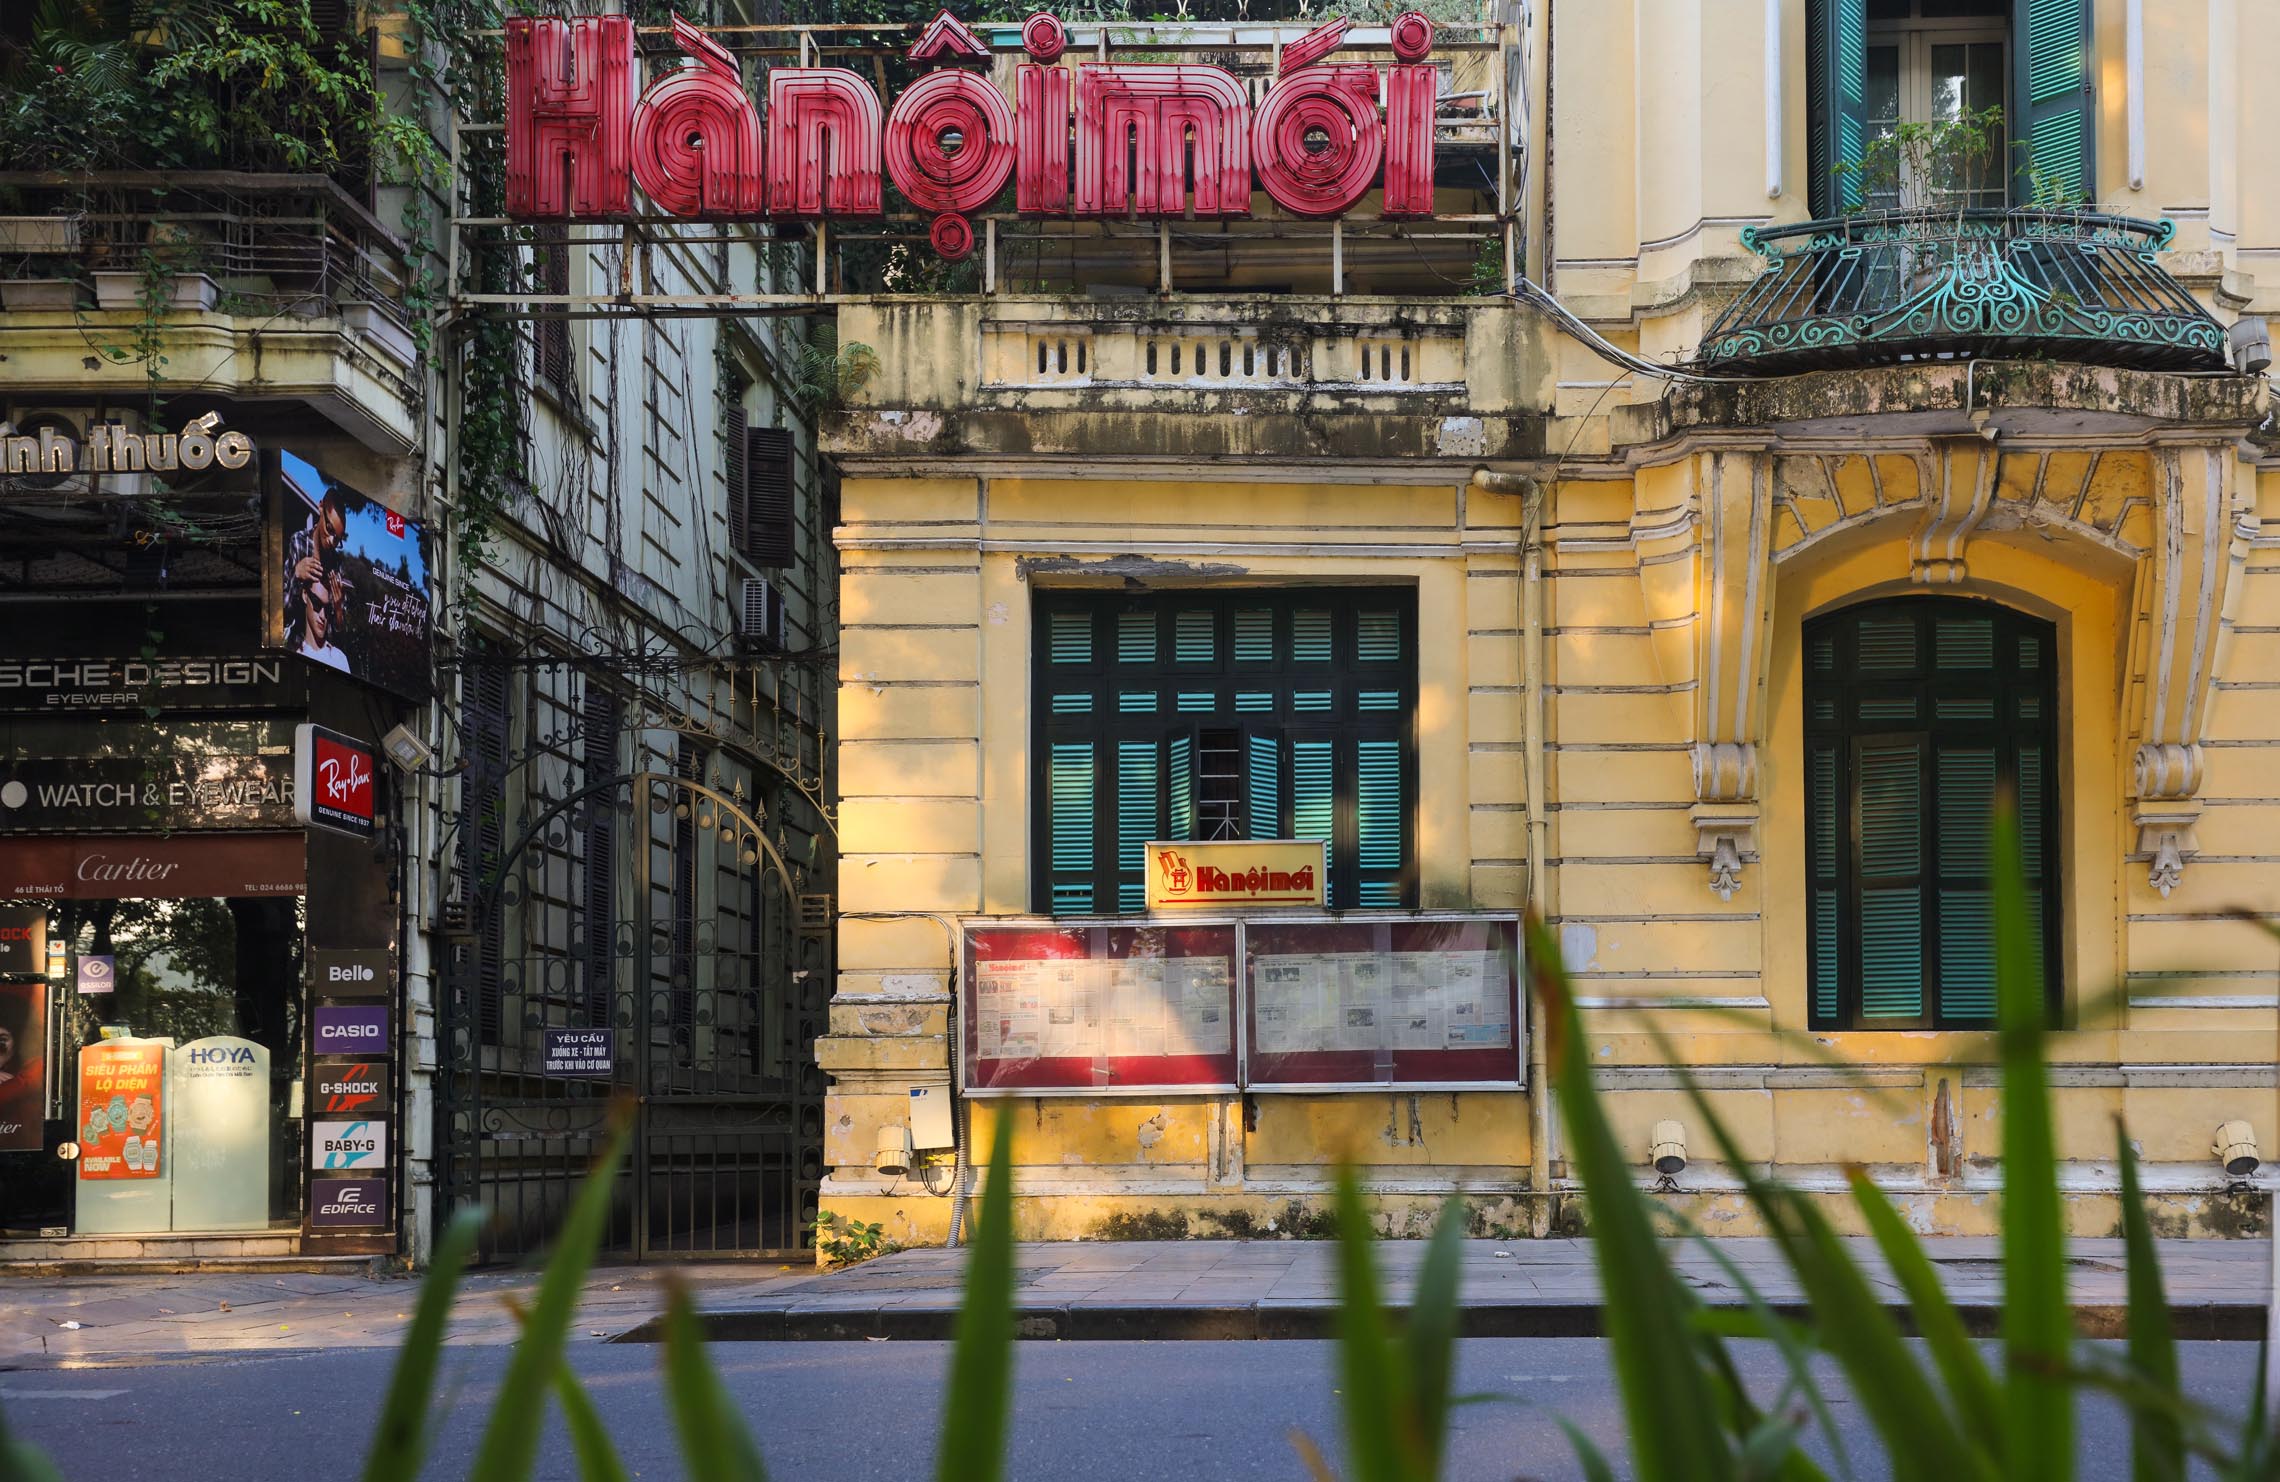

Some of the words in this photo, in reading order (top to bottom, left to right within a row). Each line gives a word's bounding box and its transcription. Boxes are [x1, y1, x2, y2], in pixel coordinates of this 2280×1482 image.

[89, 410, 251, 471] thuốc
[372, 567, 395, 584] GENUINE
[395, 577, 410, 591] SINCE
[0, 665, 110, 687] SCHE
[124, 662, 280, 685] DESIGN
[46, 693, 138, 704] EYEWEAR
[38, 783, 136, 807] WATCH
[142, 783, 161, 806] &
[168, 781, 295, 806] EYEWEAR
[318, 806, 342, 819] GENUINE
[342, 812, 357, 824] SINCE
[358, 817, 369, 827] 1937
[77, 854, 179, 881] Cartier
[14, 886, 24, 894] 46
[35, 884, 52, 894] THÁI
[329, 965, 374, 982] Bello
[321, 1025, 379, 1037] CASIO
[556, 1033, 579, 1043] YÊU
[581, 1032, 604, 1043] CẦU
[188, 1048, 256, 1064] HOYA
[551, 1044, 570, 1057] XUỐNG
[571, 1047, 579, 1056] XE
[594, 1044, 606, 1056] MÁY
[86, 1063, 116, 1077] SIÊU
[546, 1058, 564, 1070] TRƯỚC
[564, 1060, 574, 1070] KHI
[575, 1058, 586, 1070] VÀO
[586, 1060, 595, 1070] CƠ
[595, 1060, 610, 1070] QUAN
[115, 1076, 148, 1092] DIỆN
[320, 1082, 378, 1094] G-SHOCK
[324, 1140, 375, 1152] BABY-G
[84, 1162, 110, 1172] NOW
[320, 1204, 376, 1214] EDIFICE
